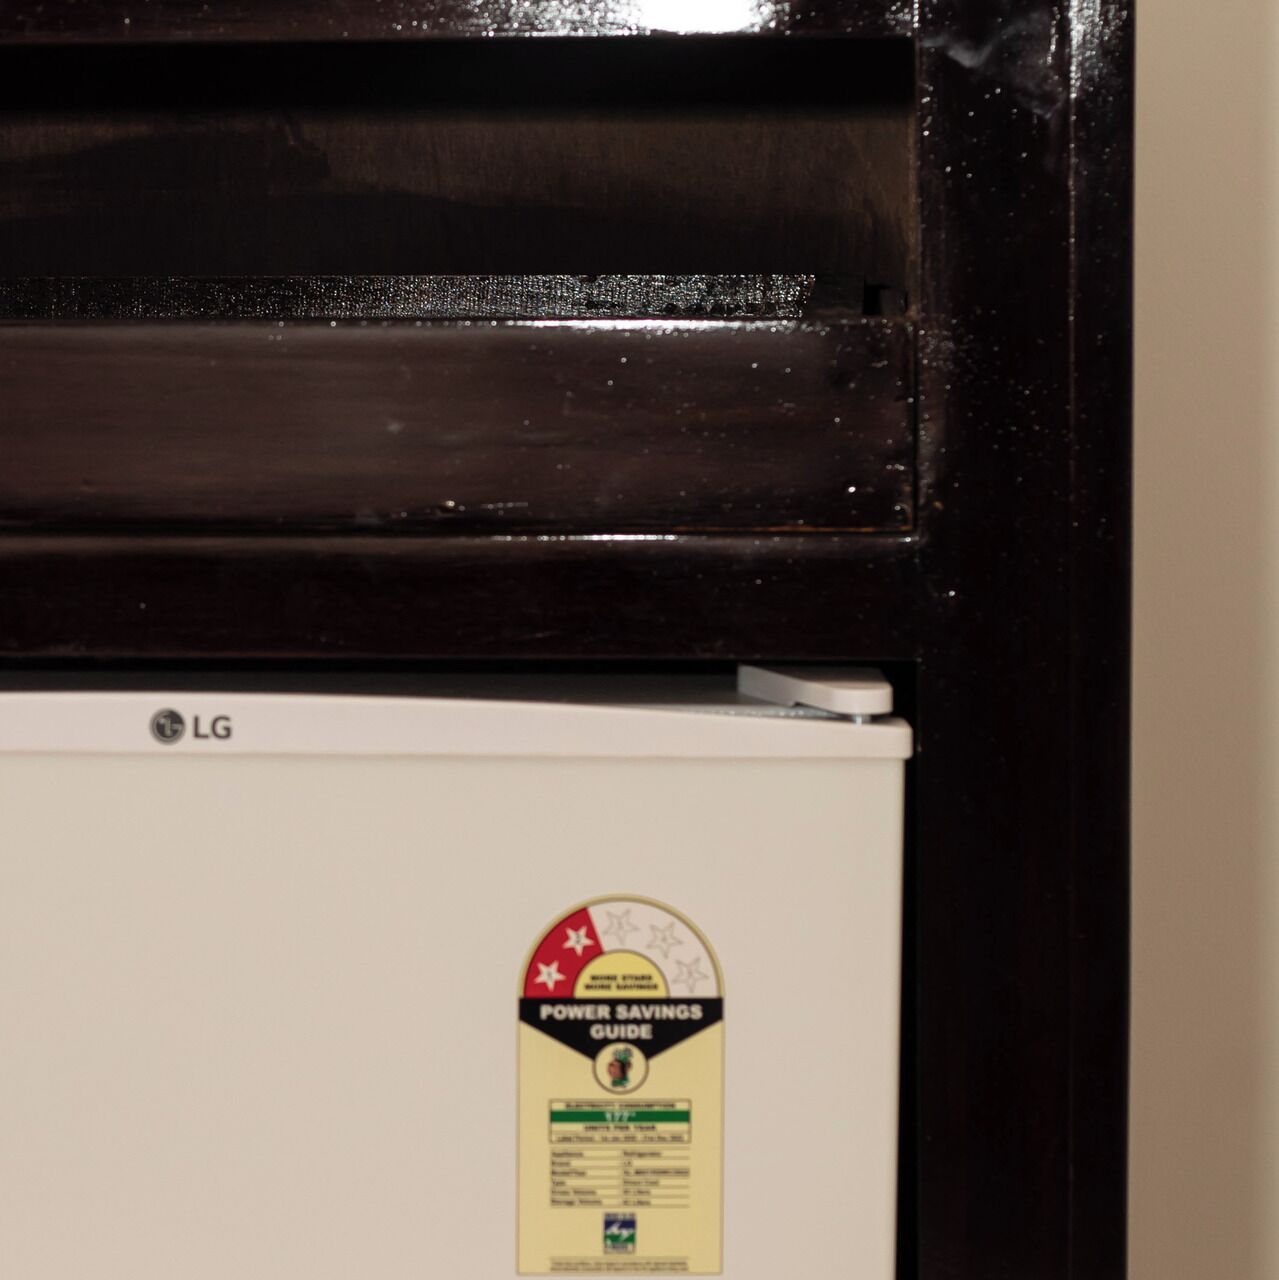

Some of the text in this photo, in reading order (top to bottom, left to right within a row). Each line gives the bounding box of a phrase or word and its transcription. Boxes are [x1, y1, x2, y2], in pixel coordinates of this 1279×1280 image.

[193, 714, 232, 740] LG
[539, 1003, 703, 1021] POWER SAVINGS
[589, 1023, 653, 1040] GUIDE
